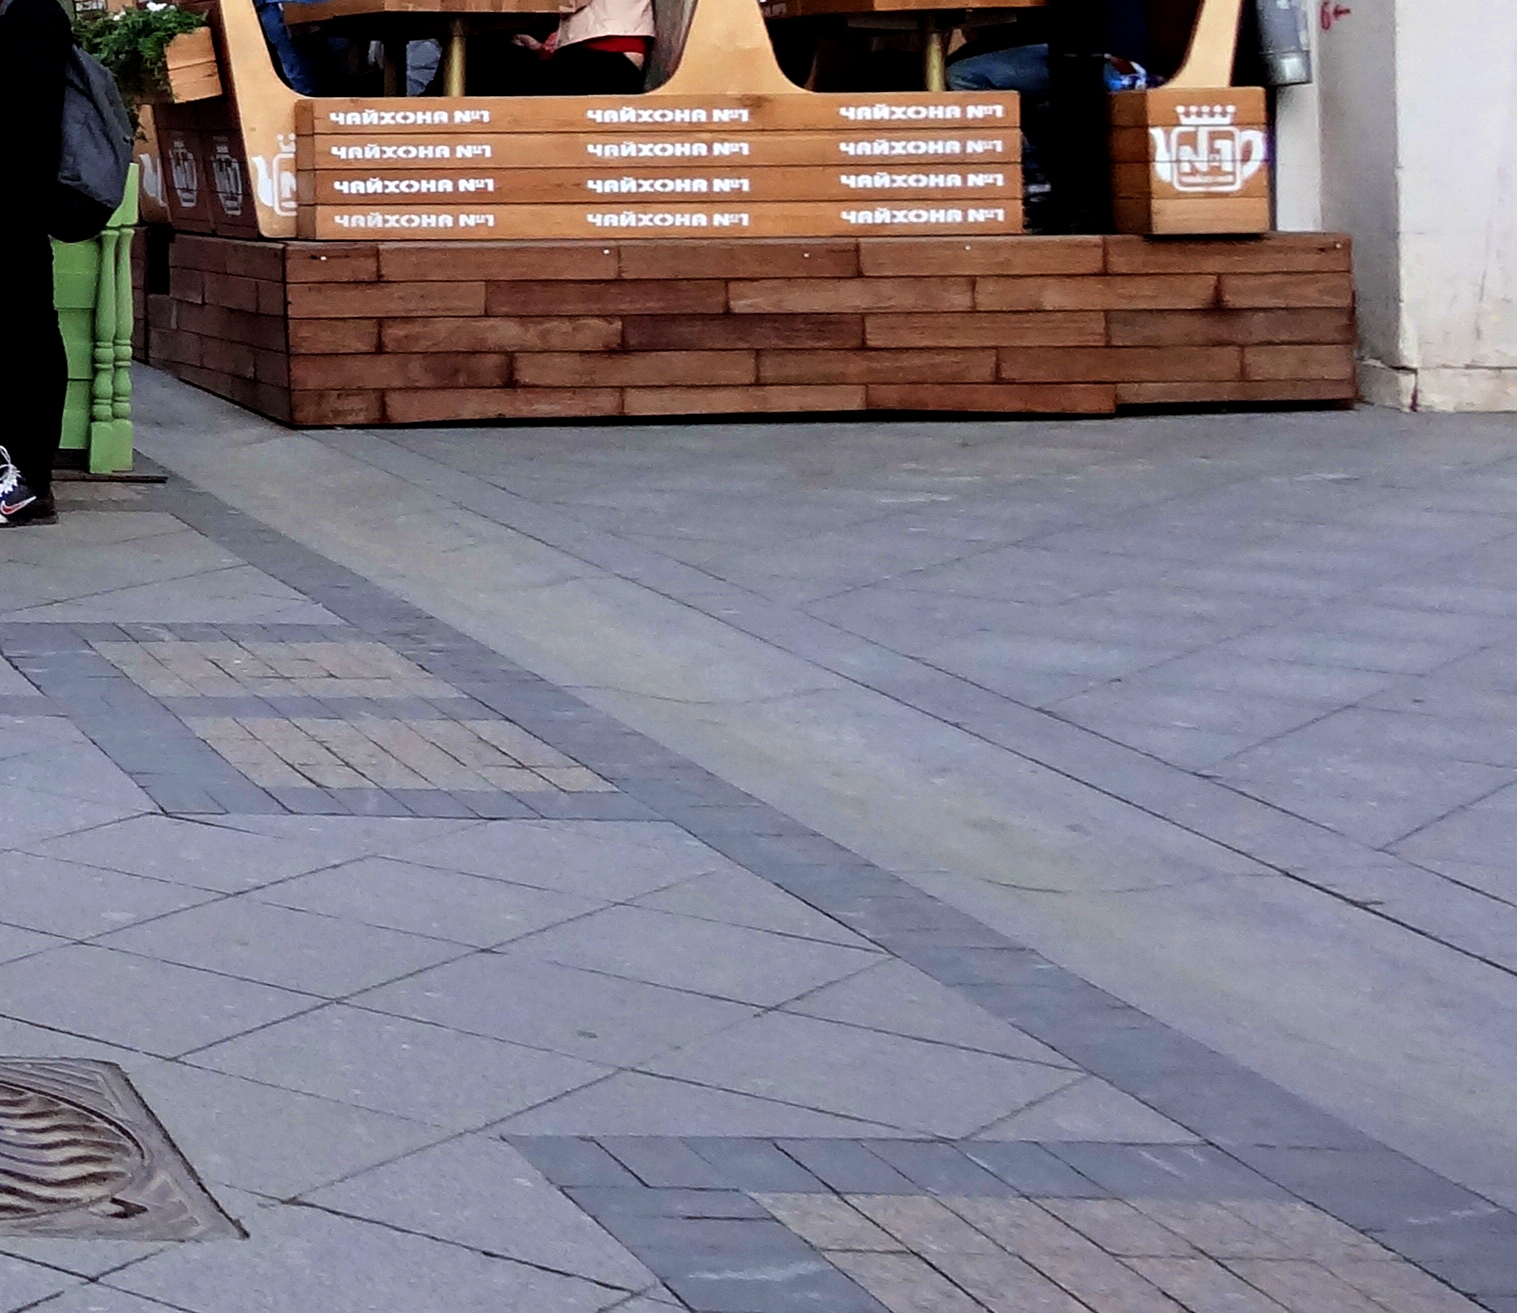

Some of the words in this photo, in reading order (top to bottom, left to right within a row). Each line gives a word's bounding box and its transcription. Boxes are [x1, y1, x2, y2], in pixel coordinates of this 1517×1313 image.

[329, 108, 449, 126] ЧАЙХОНА
[586, 106, 708, 123] ЧАЙХОНА
[839, 103, 962, 121] ЧАЙХОНА
[330, 143, 451, 160] ЧАЙХОНА
[586, 140, 708, 159] ЧАЙХОНА
[839, 138, 962, 156] ЧАЙХОНА
[333, 177, 454, 194] ЧАЙХОНА
[586, 176, 709, 194] ЧАЙХОНА
[839, 171, 963, 189] ЧАЙХОНА
[334, 211, 454, 228] ЧАЙХОНА
[586, 210, 709, 228] ЧАЙХОНА
[840, 206, 964, 224] ЧАЙХОНА
